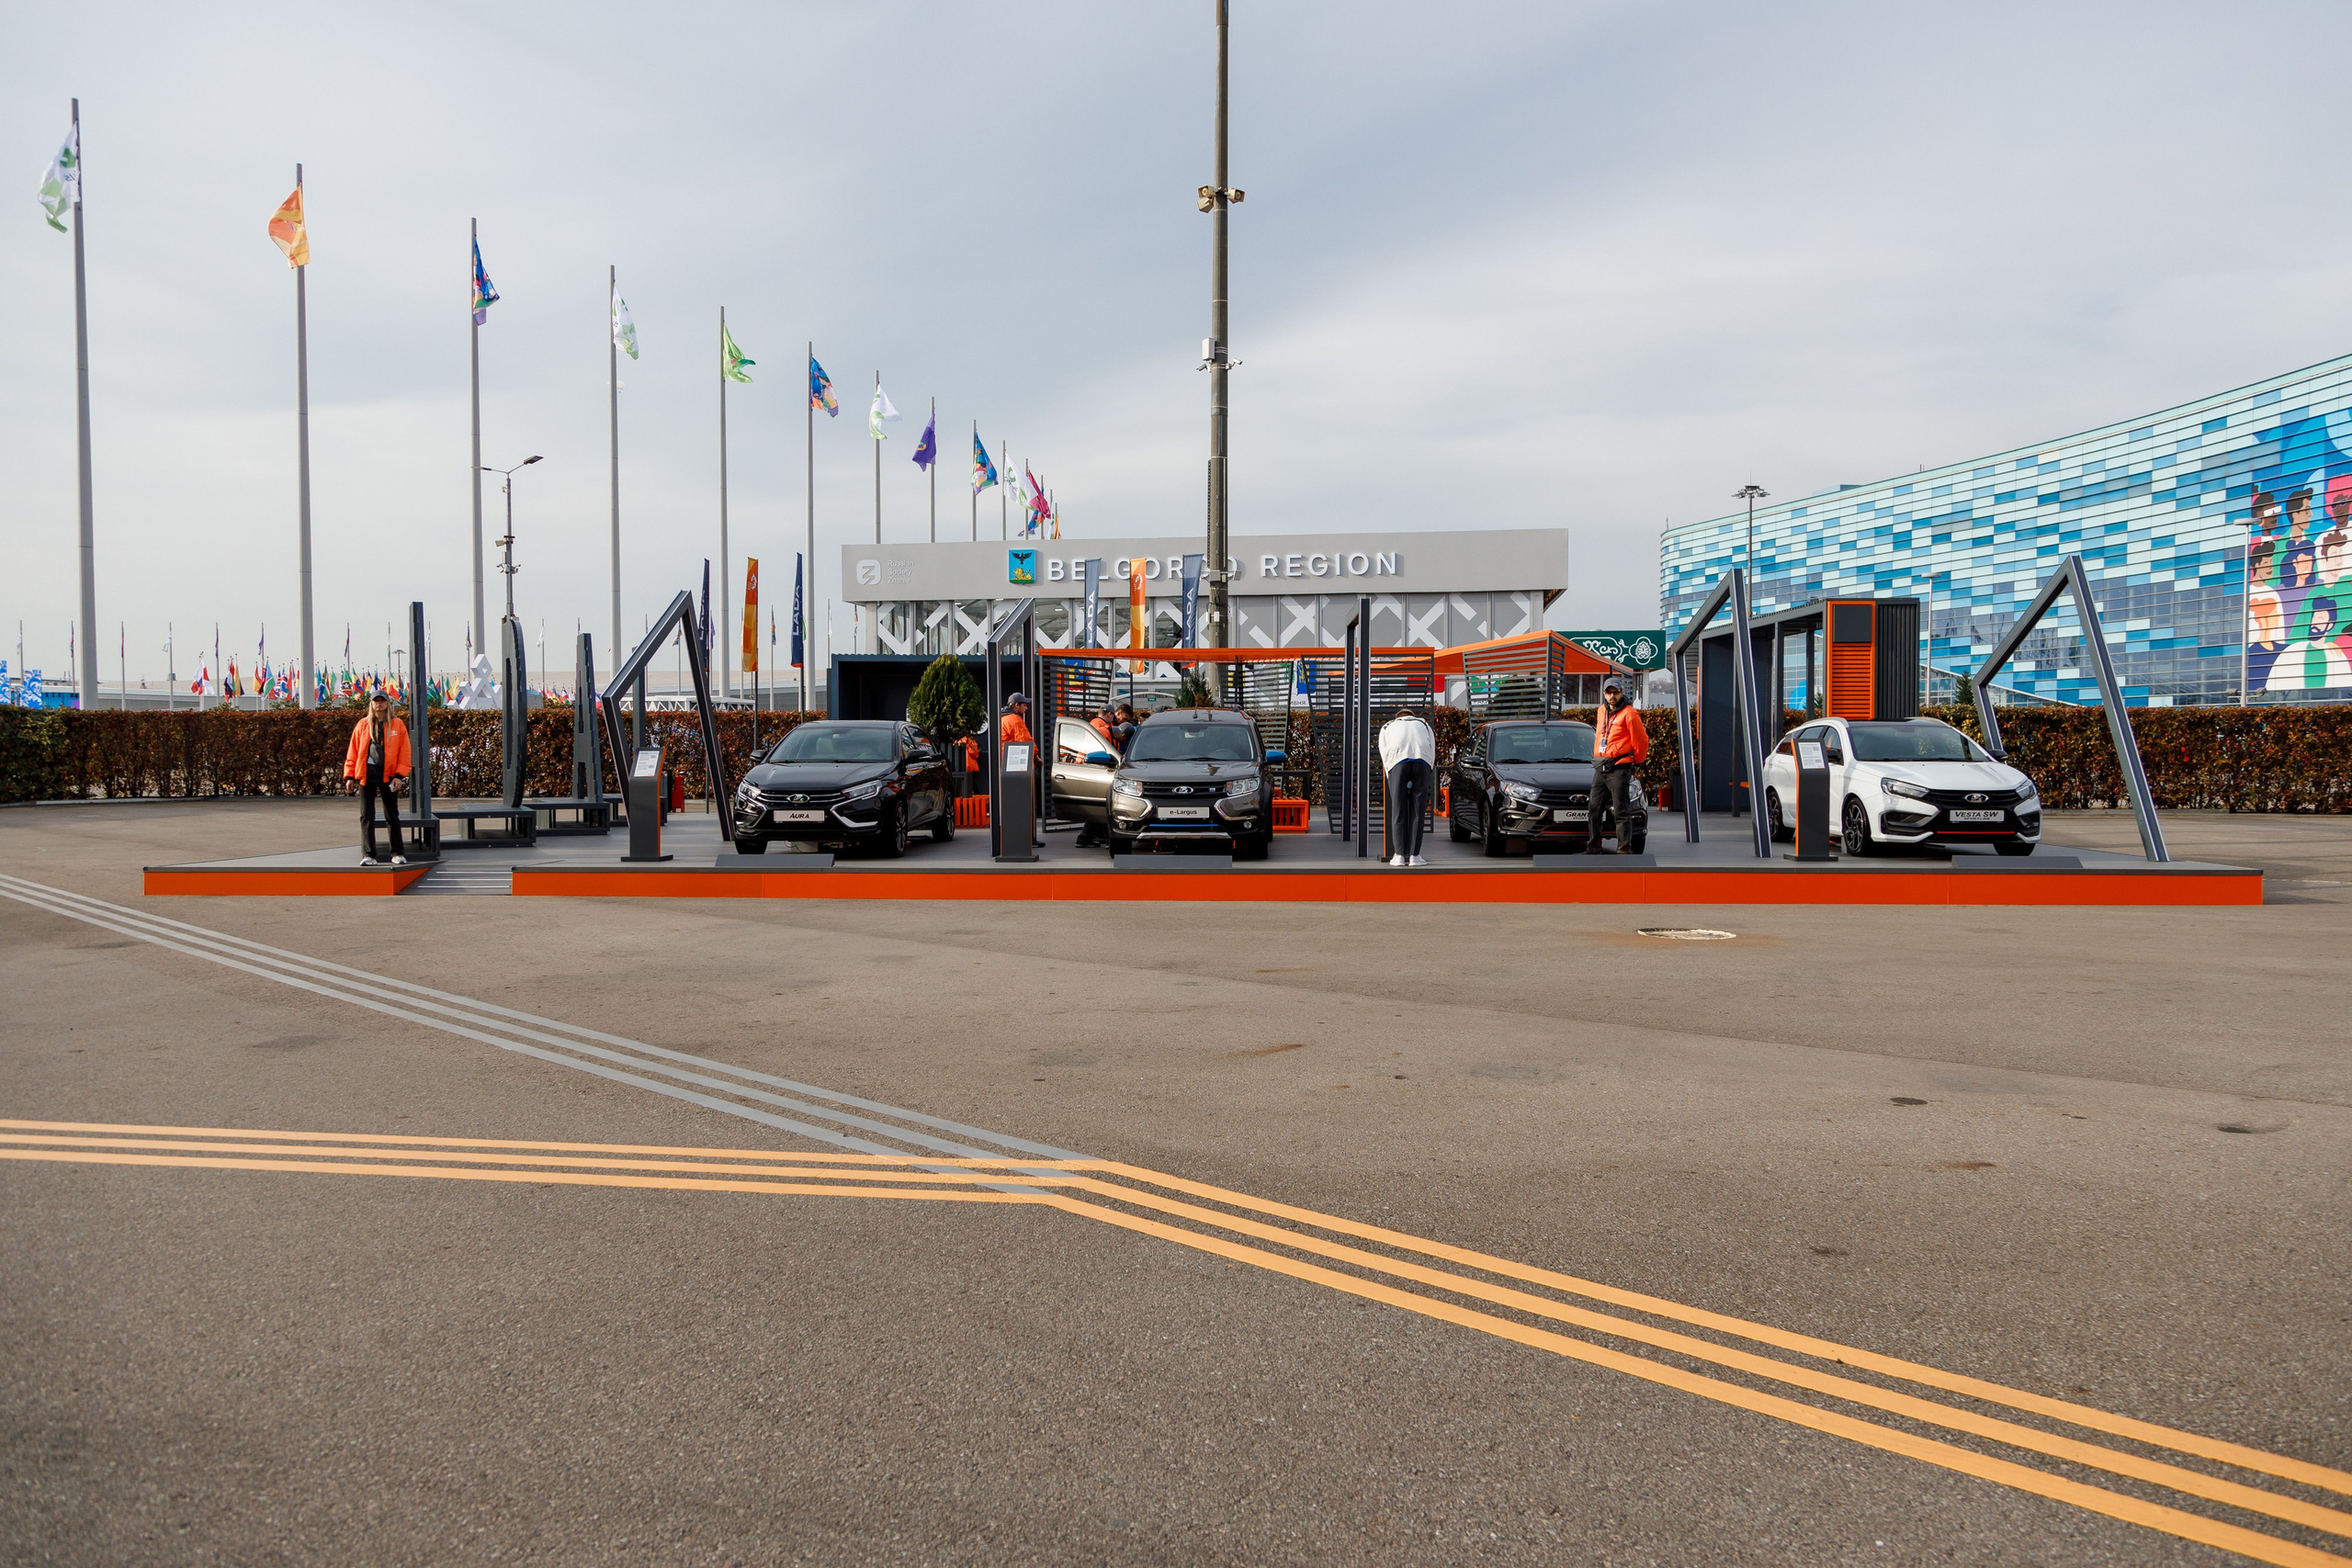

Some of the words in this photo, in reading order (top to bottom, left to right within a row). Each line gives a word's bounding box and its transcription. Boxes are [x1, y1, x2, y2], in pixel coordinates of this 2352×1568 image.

[888, 568, 912, 576] Society
[1047, 556, 1238, 581] BEGOR
[1261, 552, 1396, 578] REGION
[792, 585, 800, 637] LADA
[1087, 590, 1095, 644] LADA
[1185, 587, 1194, 640] LADA
